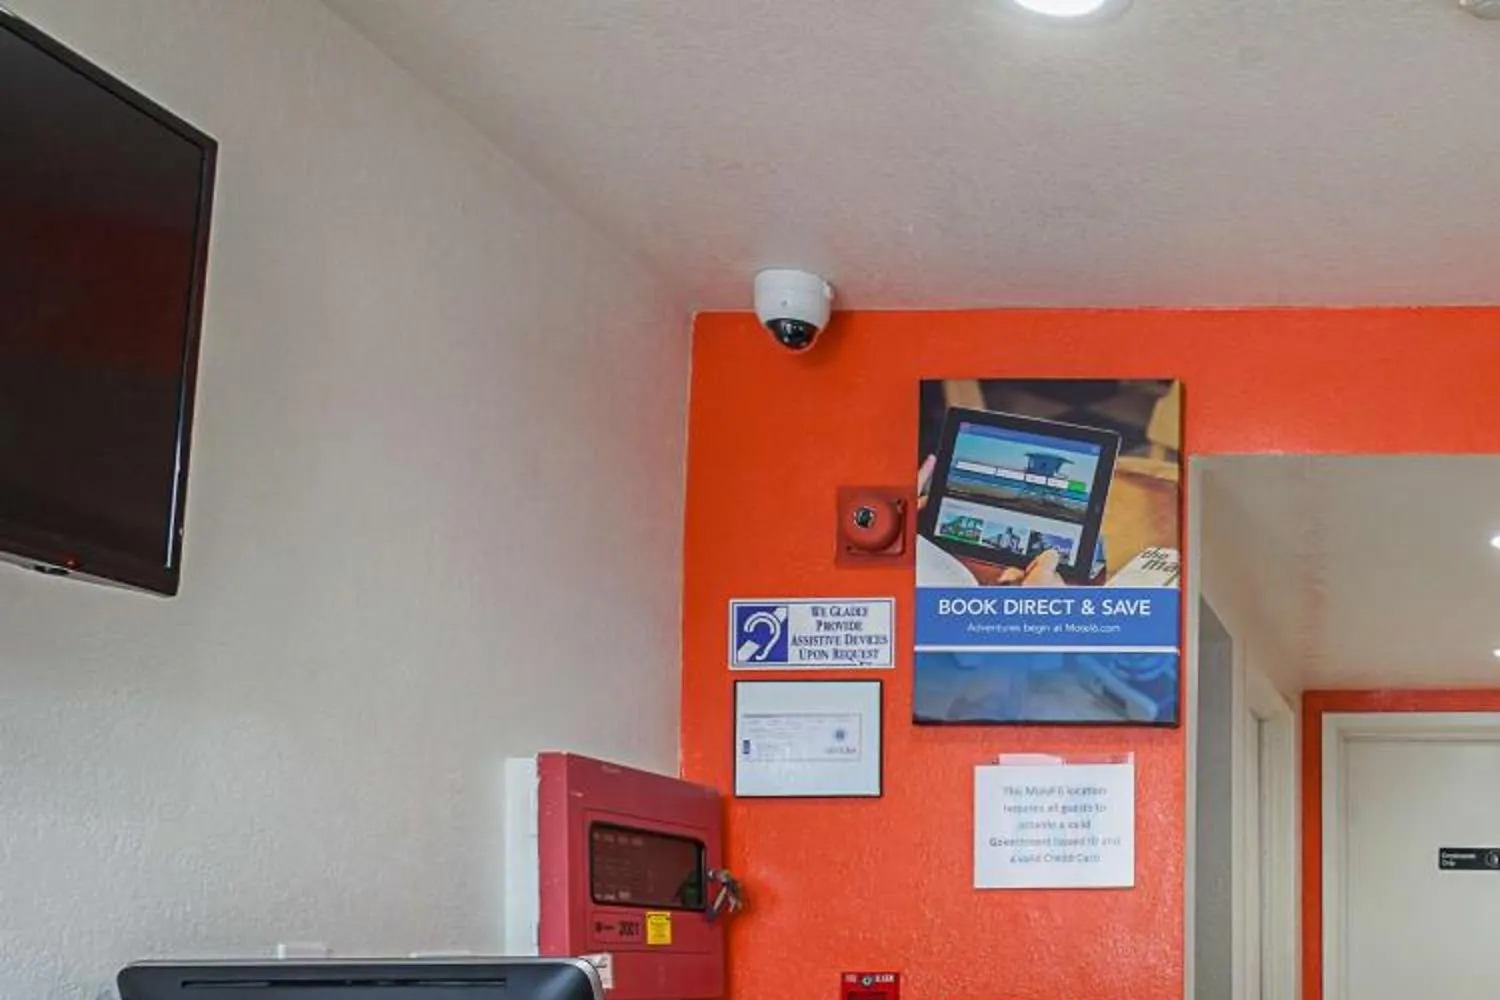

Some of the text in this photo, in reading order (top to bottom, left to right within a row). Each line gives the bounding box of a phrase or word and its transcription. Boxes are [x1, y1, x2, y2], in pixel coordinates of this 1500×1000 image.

[938, 598, 1151, 615] BOOK DIRECT & SAVE
[816, 620, 863, 632] PROVIDE
[966, 622, 1021, 633] Adventures
[1023, 621, 1050, 634] begin
[1053, 623, 1063, 633] at
[792, 633, 889, 646] ASSISTIVE DEVICES
[799, 648, 880, 662] UPON REQUEST
[1066, 785, 1107, 796] location
